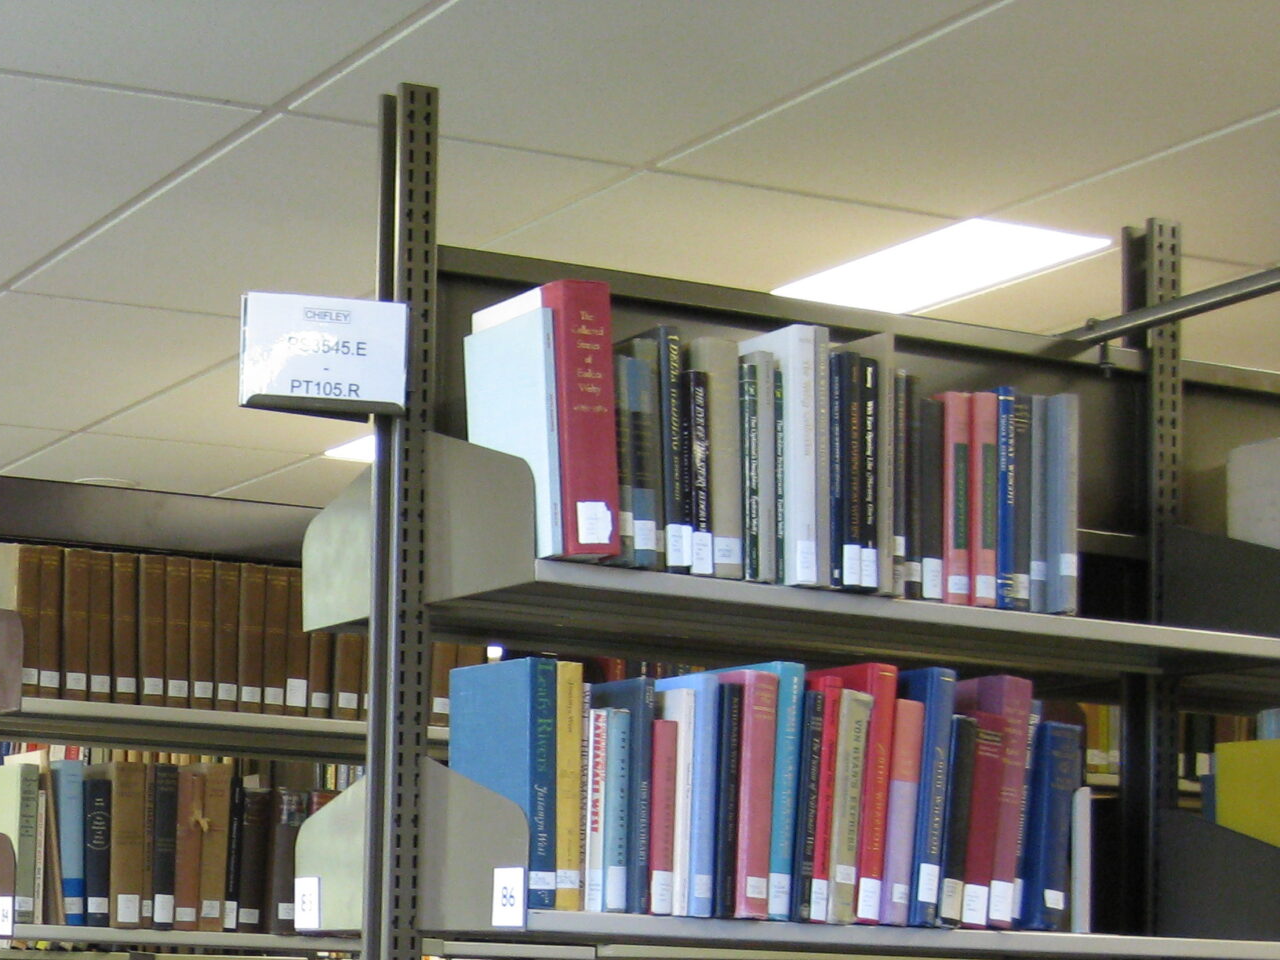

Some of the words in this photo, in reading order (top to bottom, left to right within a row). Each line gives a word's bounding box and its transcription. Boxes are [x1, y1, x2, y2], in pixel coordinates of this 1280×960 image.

[305, 311, 350, 322] CHIFLEY
[290, 379, 360, 398] PT105.R
[537, 662, 553, 715] Leafy
[538, 717, 553, 772] Rivers
[593, 713, 602, 793] NATHANAEL
[854, 719, 862, 742] VON
[534, 784, 548, 830] Jessamyn
[591, 798, 600, 832] WEST
[847, 796, 857, 852] EXPRESS
[931, 795, 942, 854] WHARTON
[537, 832, 548, 855] West
[638, 801, 647, 866] LONELYHEARTS
[501, 886, 516, 907] 86
